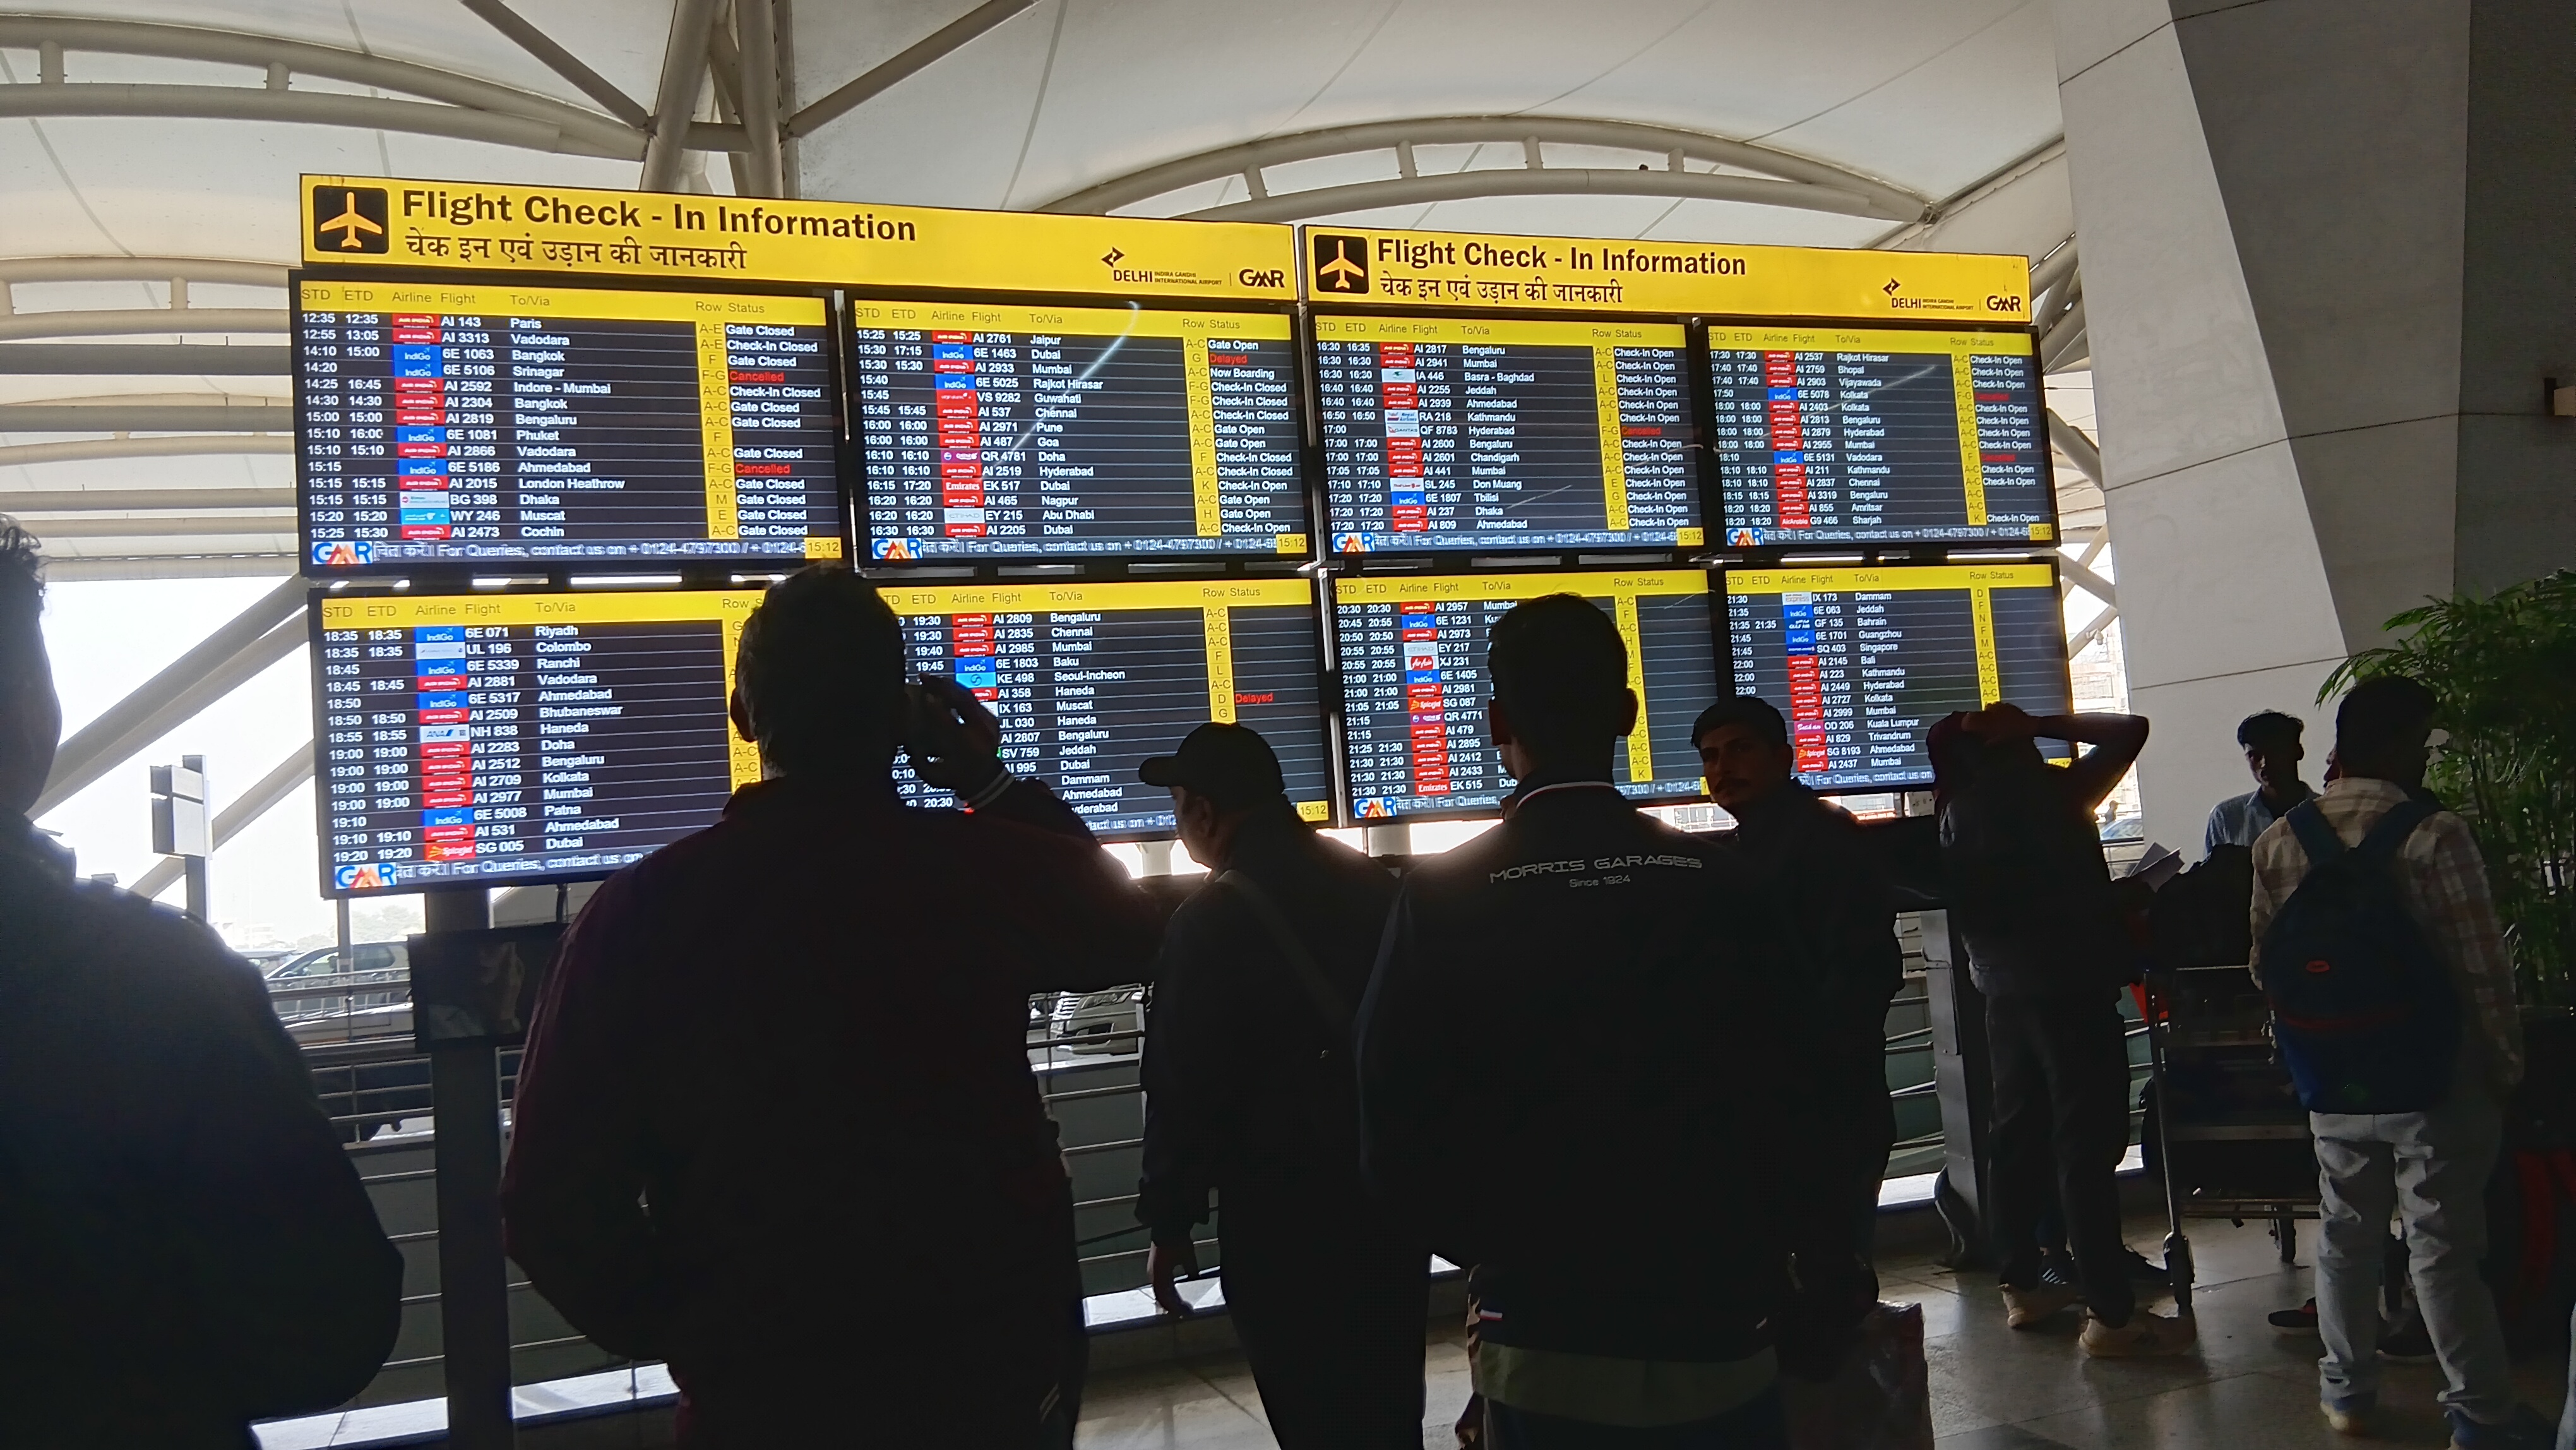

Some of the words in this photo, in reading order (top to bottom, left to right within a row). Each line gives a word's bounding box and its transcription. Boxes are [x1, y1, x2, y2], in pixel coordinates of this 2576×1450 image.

[403, 189, 513, 225] Flight
[525, 196, 641, 227] Check
[674, 203, 705, 231] In
[718, 205, 916, 241] Information
[405, 226, 451, 257] चेक
[458, 237, 492, 261] इन
[498, 232, 535, 263] एवं
[542, 241, 602, 268] उड़ान
[609, 236, 643, 265] की
[649, 241, 748, 270] जानकारी
[1378, 238, 1456, 269] Flight
[1464, 242, 1547, 268] Check
[1571, 246, 1593, 270] In
[1603, 248, 1746, 275] Information
[1113, 269, 1153, 283] DELHI
[1380, 270, 1413, 296] चेक
[1417, 279, 1441, 299] इन
[1446, 273, 1471, 301] एवं
[1476, 281, 1520, 304] उड़ान
[1524, 277, 1548, 301] की
[1552, 279, 1623, 304] जानकारी
[301, 289, 331, 300] STD
[345, 290, 373, 301] ETD
[391, 292, 432, 303] Airline
[441, 292, 476, 306] Flight
[509, 294, 550, 306] To/Via
[695, 301, 722, 312] Row
[728, 302, 765, 313] Status
[1892, 297, 1921, 309] DELHI
[302, 313, 336, 323] 12:35
[345, 313, 379, 325] 12:35
[441, 316, 455, 327] AI
[458, 316, 482, 327] 143
[510, 318, 542, 329] Paris
[699, 323, 722, 334] A-E
[725, 324, 753, 335] Gate
[755, 325, 795, 337] Closed
[857, 329, 885, 340] 15:25
[893, 330, 921, 341] 15:25
[972, 333, 984, 343] AI
[986, 333, 1011, 344] 2761
[1030, 334, 1061, 347] Jaipur
[1185, 339, 1206, 349] A-C
[1208, 339, 1231, 349] Gate
[1232, 340, 1259, 352] Open
[1316, 342, 1340, 351] 16:30
[1347, 342, 1371, 352] 16:35
[1414, 344, 1424, 354] AI
[1425, 344, 1447, 354] 2817
[1462, 345, 1506, 357] Bengaluru
[1595, 347, 1613, 357] A-C
[1614, 348, 1650, 357] Check-In
[1653, 348, 1674, 359] Open
[309, 477, 343, 488] 15:15
[352, 477, 386, 488] 15:15
[448, 477, 463, 489] AI
[465, 477, 498, 489] 2015
[518, 477, 565, 489] London
[566, 478, 626, 489] Heathrow
[708, 478, 733, 489] A-C
[735, 478, 763, 489] Gate
[765, 479, 805, 489] Closed
[867, 480, 896, 491] 16:15
[903, 480, 931, 491] 17:20
[945, 482, 981, 491] Emirates
[983, 481, 998, 491] EK
[1001, 481, 1020, 491] 517
[1040, 481, 1070, 491] Dubai
[1202, 481, 1210, 490] K
[1218, 480, 1258, 491] Check-In
[1259, 480, 1288, 494] Open
[1327, 479, 1351, 489] 17:10
[1357, 479, 1381, 489] 17:10
[1424, 479, 1438, 489] SL
[1438, 479, 1456, 489] 245
[1472, 479, 1491, 489] Don
[1493, 479, 1522, 491] Muang
[1611, 478, 1618, 488] E
[1625, 478, 1662, 488] Check-In
[1662, 478, 1686, 489] Open
[808, 541, 839, 552] 15:12
[1812, 593, 1822, 602] IX
[1823, 592, 1838, 602] 173
[1855, 592, 1892, 601] Dammam
[1976, 589, 1984, 598] D
[322, 606, 353, 619] STD
[367, 605, 397, 617] ETD
[415, 605, 456, 616] Airline
[465, 604, 501, 616] Flight
[535, 602, 576, 613] To/Via
[722, 598, 749, 609] Row
[1337, 604, 1361, 614] 20:30
[1366, 604, 1392, 614] 20:30
[1434, 602, 1445, 612] AI
[1446, 601, 1469, 611] 2957
[1617, 596, 1635, 606] A-C
[913, 615, 941, 626] 19:30
[993, 614, 1005, 625] AI
[1006, 613, 1033, 624] 2809
[1050, 612, 1102, 625] Bengaluru
[1206, 608, 1226, 618] A-C
[323, 630, 359, 642] 18:35
[368, 629, 402, 640] 18:35
[426, 633, 454, 642] IndiGo
[465, 627, 484, 638] 6E
[485, 626, 509, 638] 071
[535, 625, 579, 638] Riyadh
[999, 703, 1010, 714] IX
[1013, 702, 1033, 713] 163
[1056, 700, 1094, 712] Muscat
[1218, 693, 1226, 704] D
[1235, 693, 1273, 705] Delayed
[1345, 702, 1369, 712] 21:05
[1374, 700, 1400, 711] 21:05
[1443, 698, 1457, 708] SG
[1459, 697, 1476, 707] 087
[328, 731, 363, 743] 18:55
[373, 729, 407, 741] 18:55
[470, 726, 491, 738] NH
[493, 724, 518, 736] 838
[540, 722, 590, 734] Haneda
[1824, 721, 1838, 731] OD
[1839, 720, 1854, 730] 206
[1866, 719, 1890, 729] Kuala
[1890, 718, 1919, 729] Lumpur
[1489, 859, 1585, 884] MORRIS
[1594, 854, 1703, 870] GARAGES
